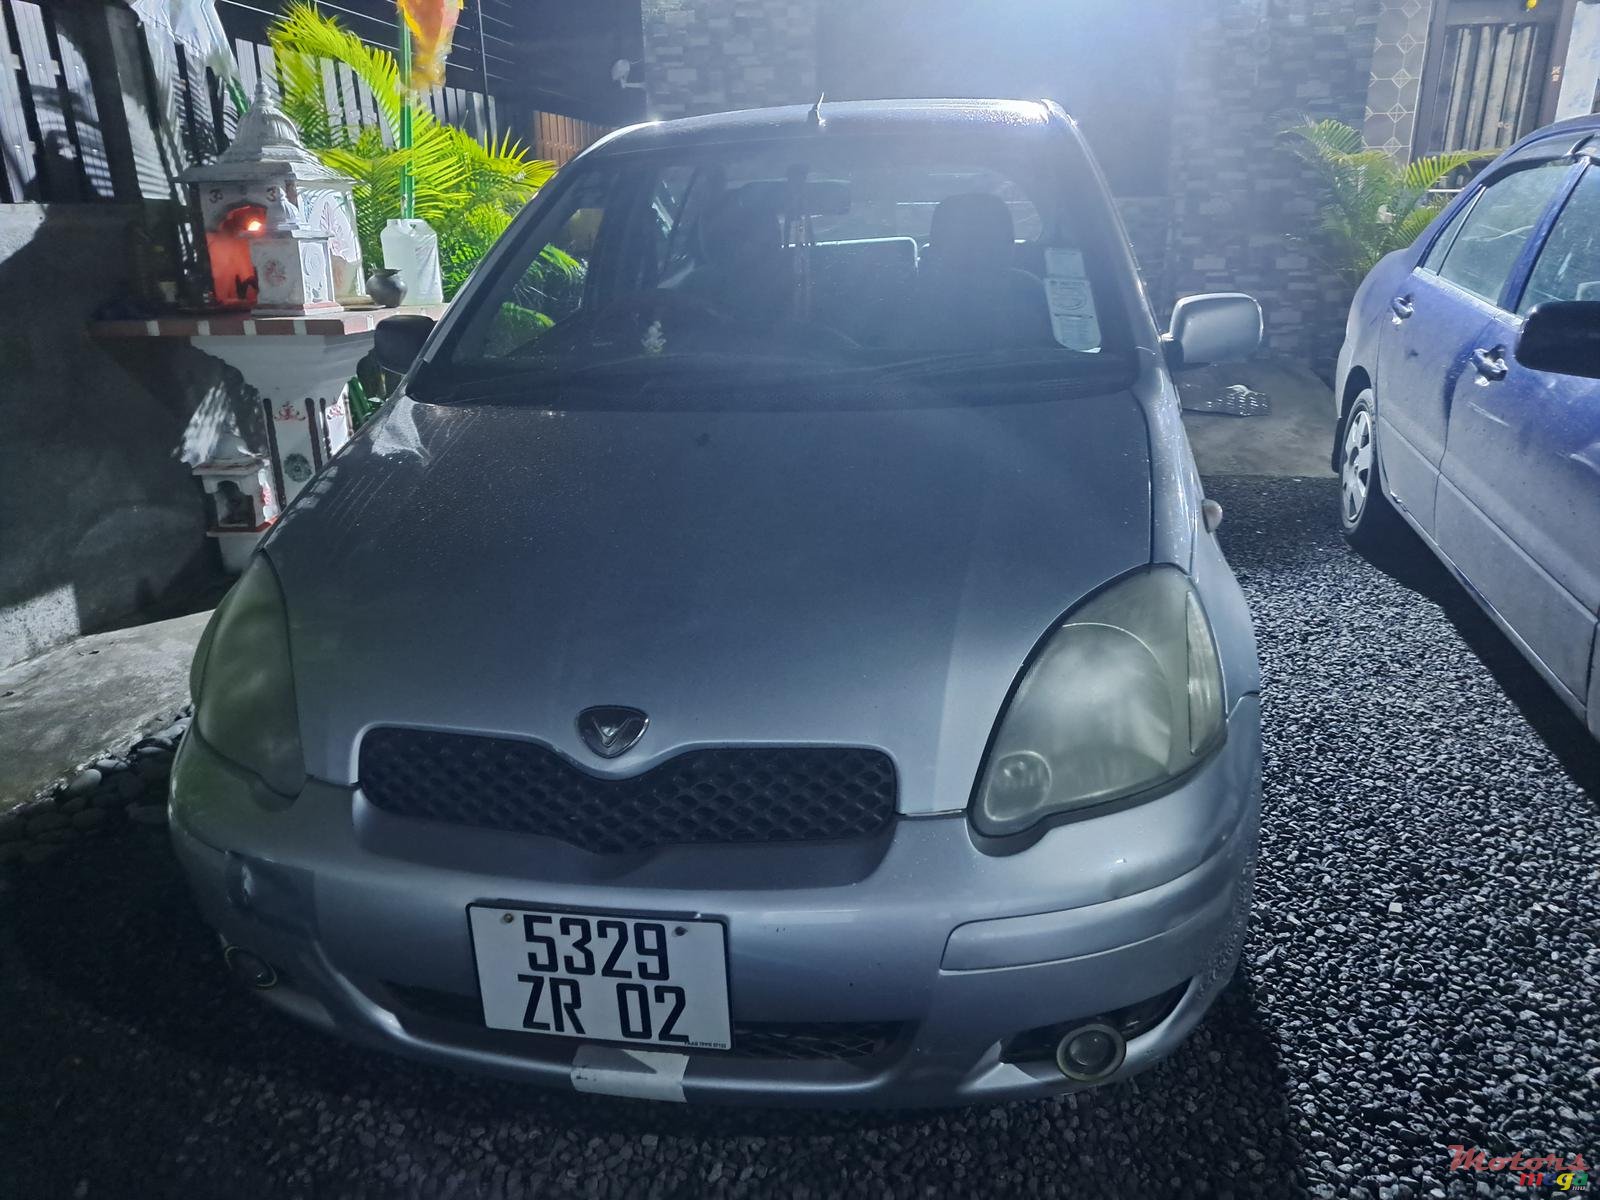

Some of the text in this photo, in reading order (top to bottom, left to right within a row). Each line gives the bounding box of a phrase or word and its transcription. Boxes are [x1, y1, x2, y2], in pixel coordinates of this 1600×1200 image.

[523, 914, 669, 981] 5329
[517, 974, 689, 1042] ZR 02
